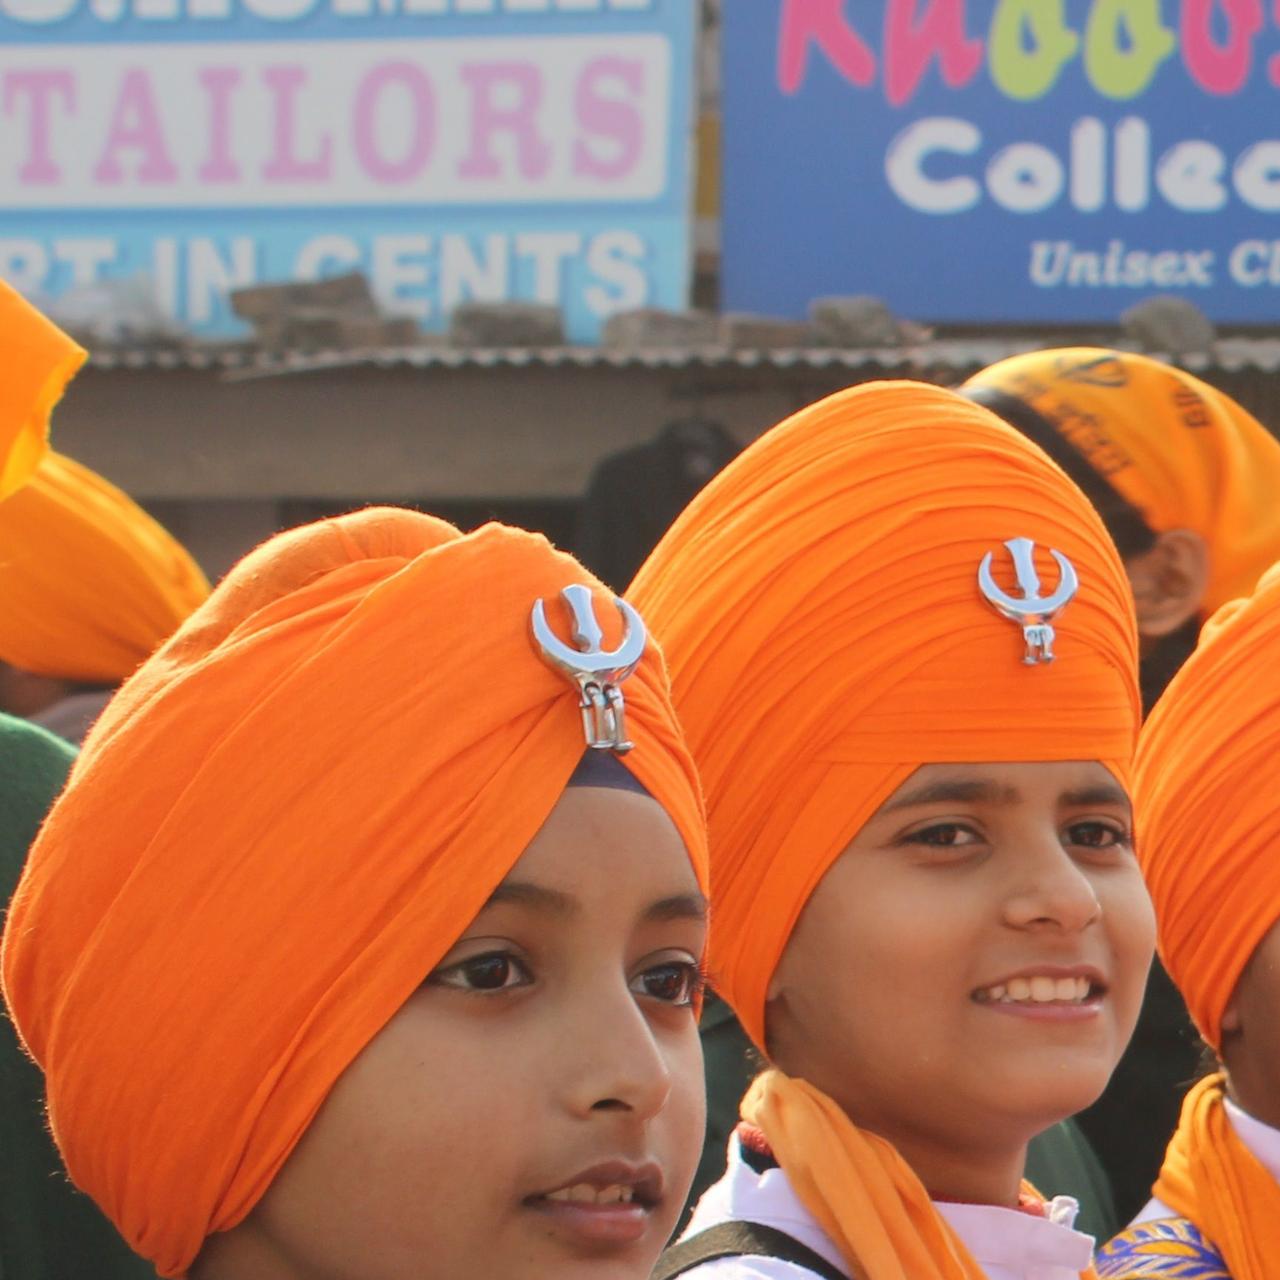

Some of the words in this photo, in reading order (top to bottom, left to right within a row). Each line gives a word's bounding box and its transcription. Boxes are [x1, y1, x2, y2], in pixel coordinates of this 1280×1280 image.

[3, 55, 647, 187] TAILORS
[153, 236, 256, 322] IN
[1029, 239, 1214, 286] Unisex
